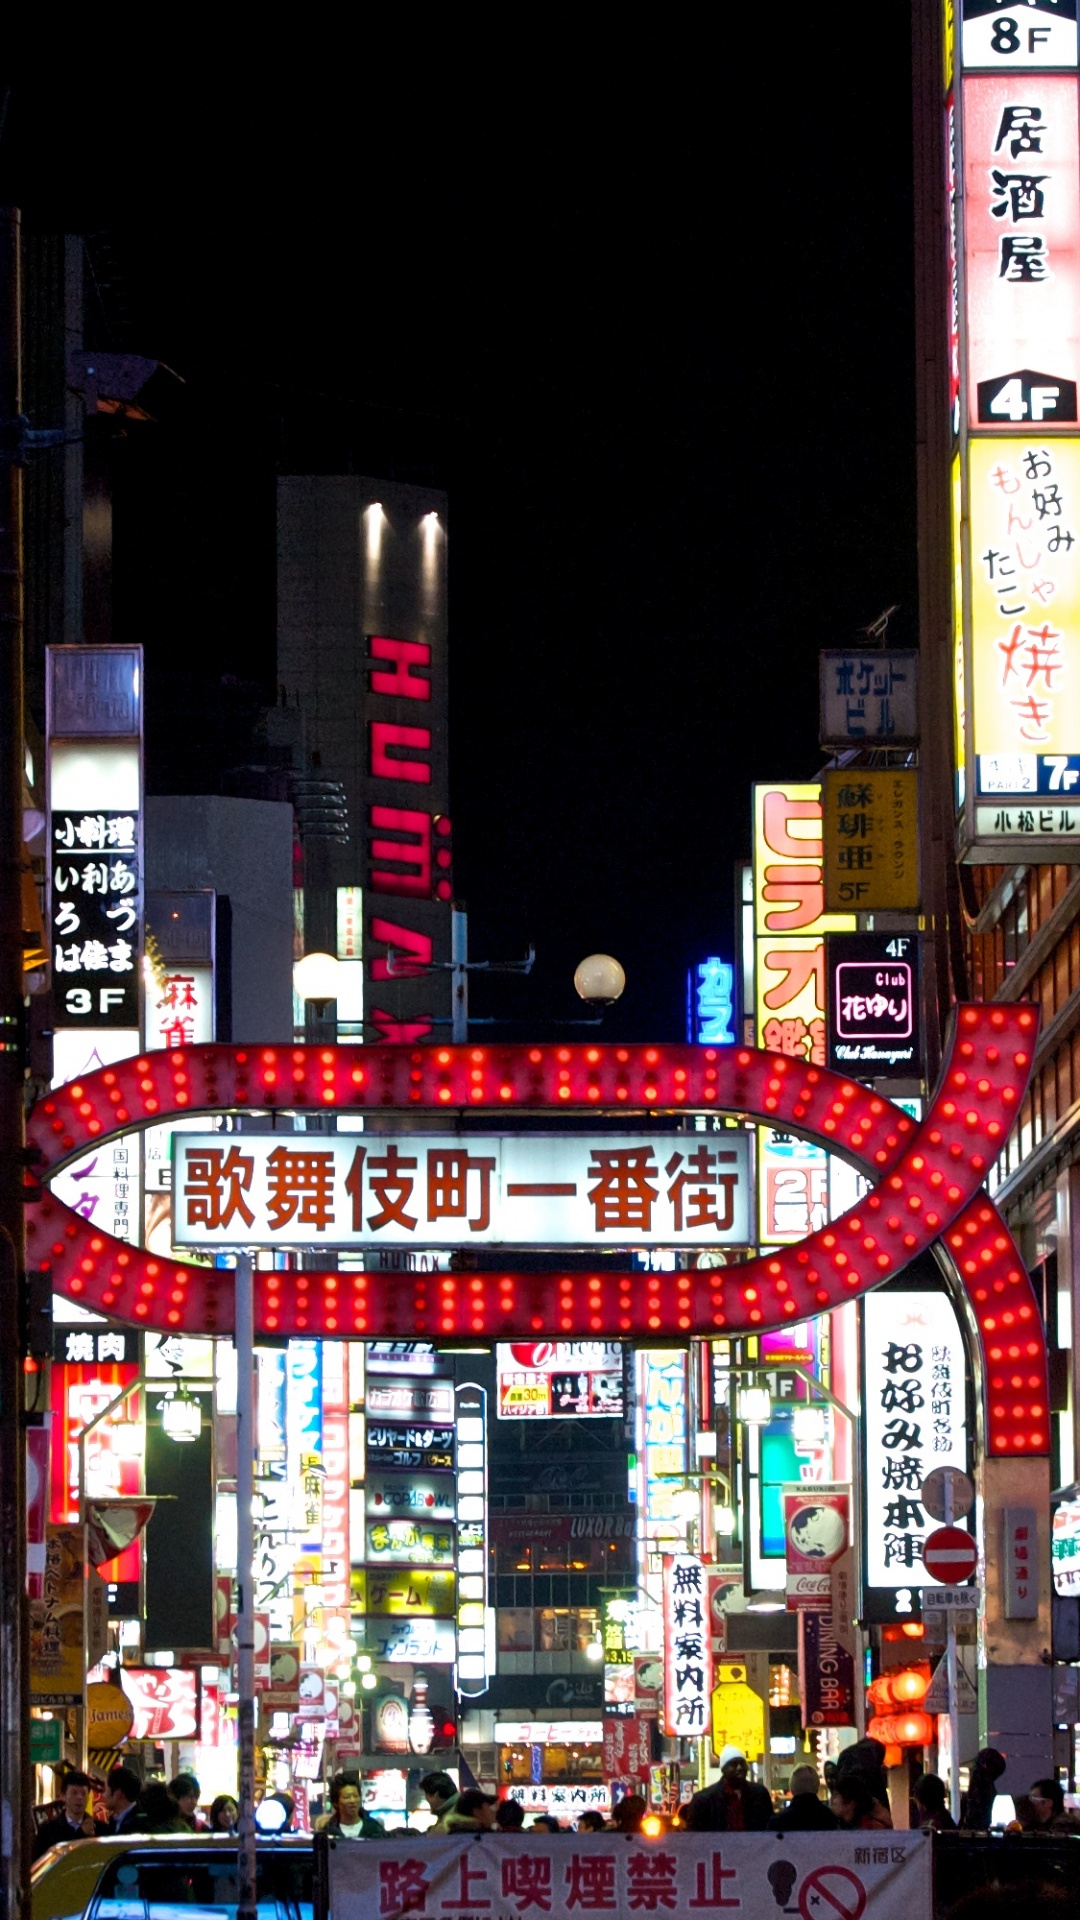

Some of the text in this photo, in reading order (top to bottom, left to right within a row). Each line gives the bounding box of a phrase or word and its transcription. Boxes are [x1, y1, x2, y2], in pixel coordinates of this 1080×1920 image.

[990, 16, 1052, 55] 8F
[994, 106, 1051, 283] 居酒屋
[991, 379, 1060, 421] 4F
[1023, 450, 1076, 553] お好み
[983, 550, 1026, 614] たこ
[998, 625, 1064, 740] 焼き
[1043, 755, 1079, 791] 7F
[55, 815, 135, 849] 小料理
[994, 810, 1076, 832] 小松ビル
[838, 882, 870, 901] 5F
[886, 938, 910, 957] 4F
[876, 972, 906, 986] Club
[65, 988, 126, 1014] 3F
[155, 974, 199, 1049] 麻雀
[842, 993, 908, 1022] 花ゆり
[184, 1145, 739, 1232] 歌舞伎町一番街
[66, 1332, 125, 1361] 焼肉
[881, 1342, 925, 1568] お好み焼本陣
[672, 1563, 706, 1726] 無料案内所
[819, 1677, 840, 1711] BAR
[853, 1846, 908, 1864] 新宿区
[378, 1853, 741, 1914] 路上喫煙禁止
